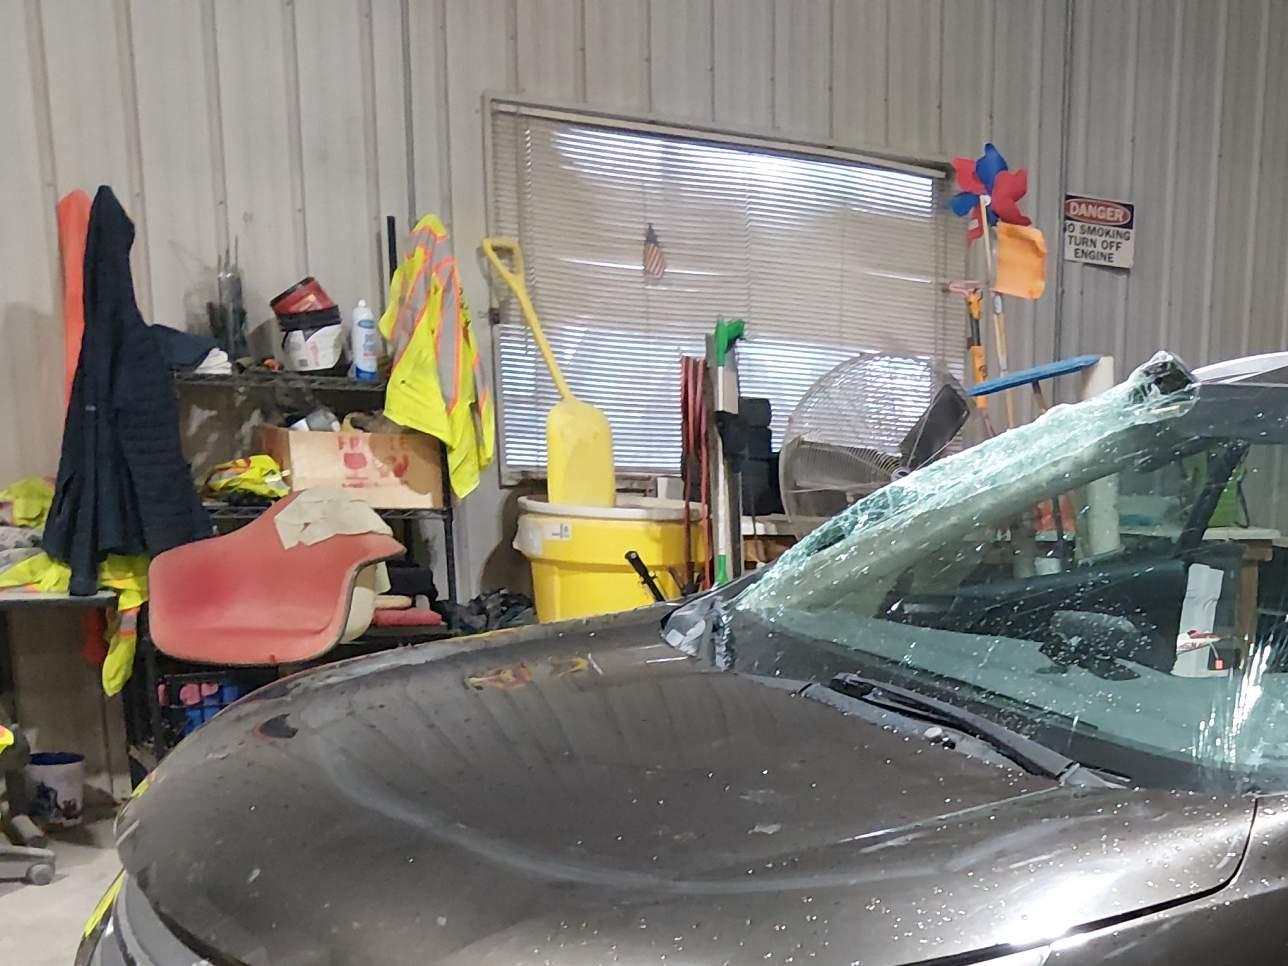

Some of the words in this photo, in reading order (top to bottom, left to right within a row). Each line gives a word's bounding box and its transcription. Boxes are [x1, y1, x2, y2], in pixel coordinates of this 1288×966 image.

[1069, 202, 1124, 222] DANGER
[1080, 224, 1131, 241] SMOKING
[1068, 235, 1097, 248] TURN
[1101, 240, 1123, 251] OFF
[1074, 248, 1115, 263] ENGINE
